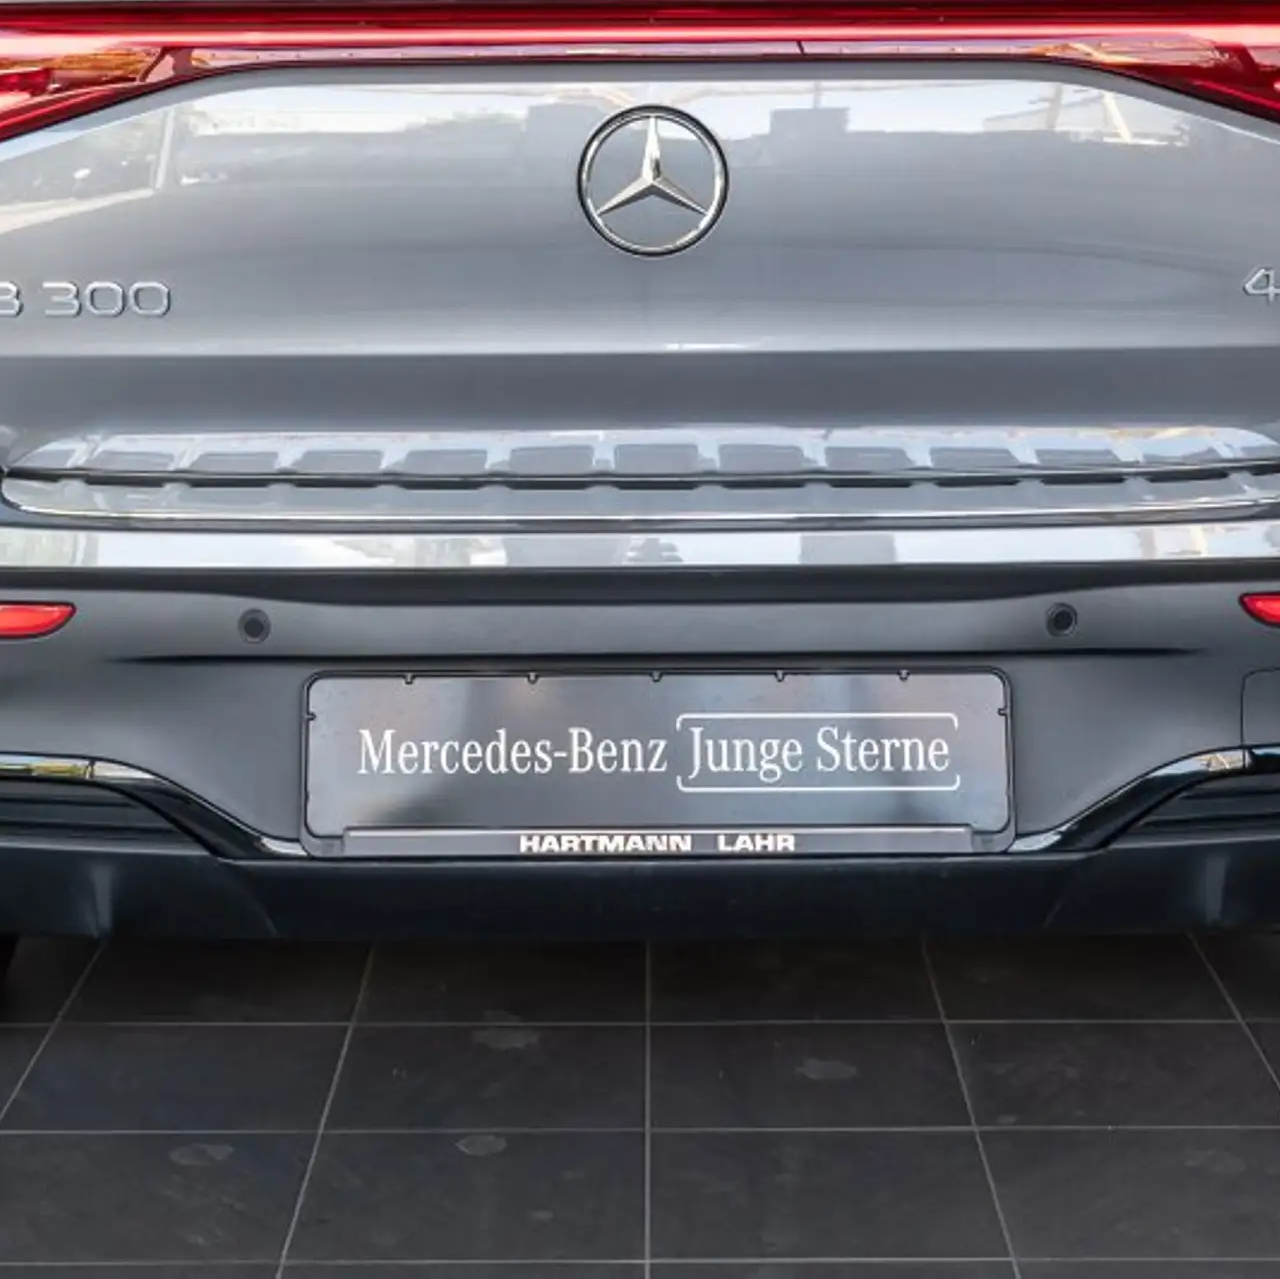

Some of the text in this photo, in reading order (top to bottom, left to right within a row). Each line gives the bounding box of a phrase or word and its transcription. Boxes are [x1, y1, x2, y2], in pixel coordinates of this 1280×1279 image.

[40, 279, 172, 318] 300
[357, 725, 950, 783] Mercedes-Benz Junge Sterne
[519, 833, 796, 854] HARTMANN LAHR
